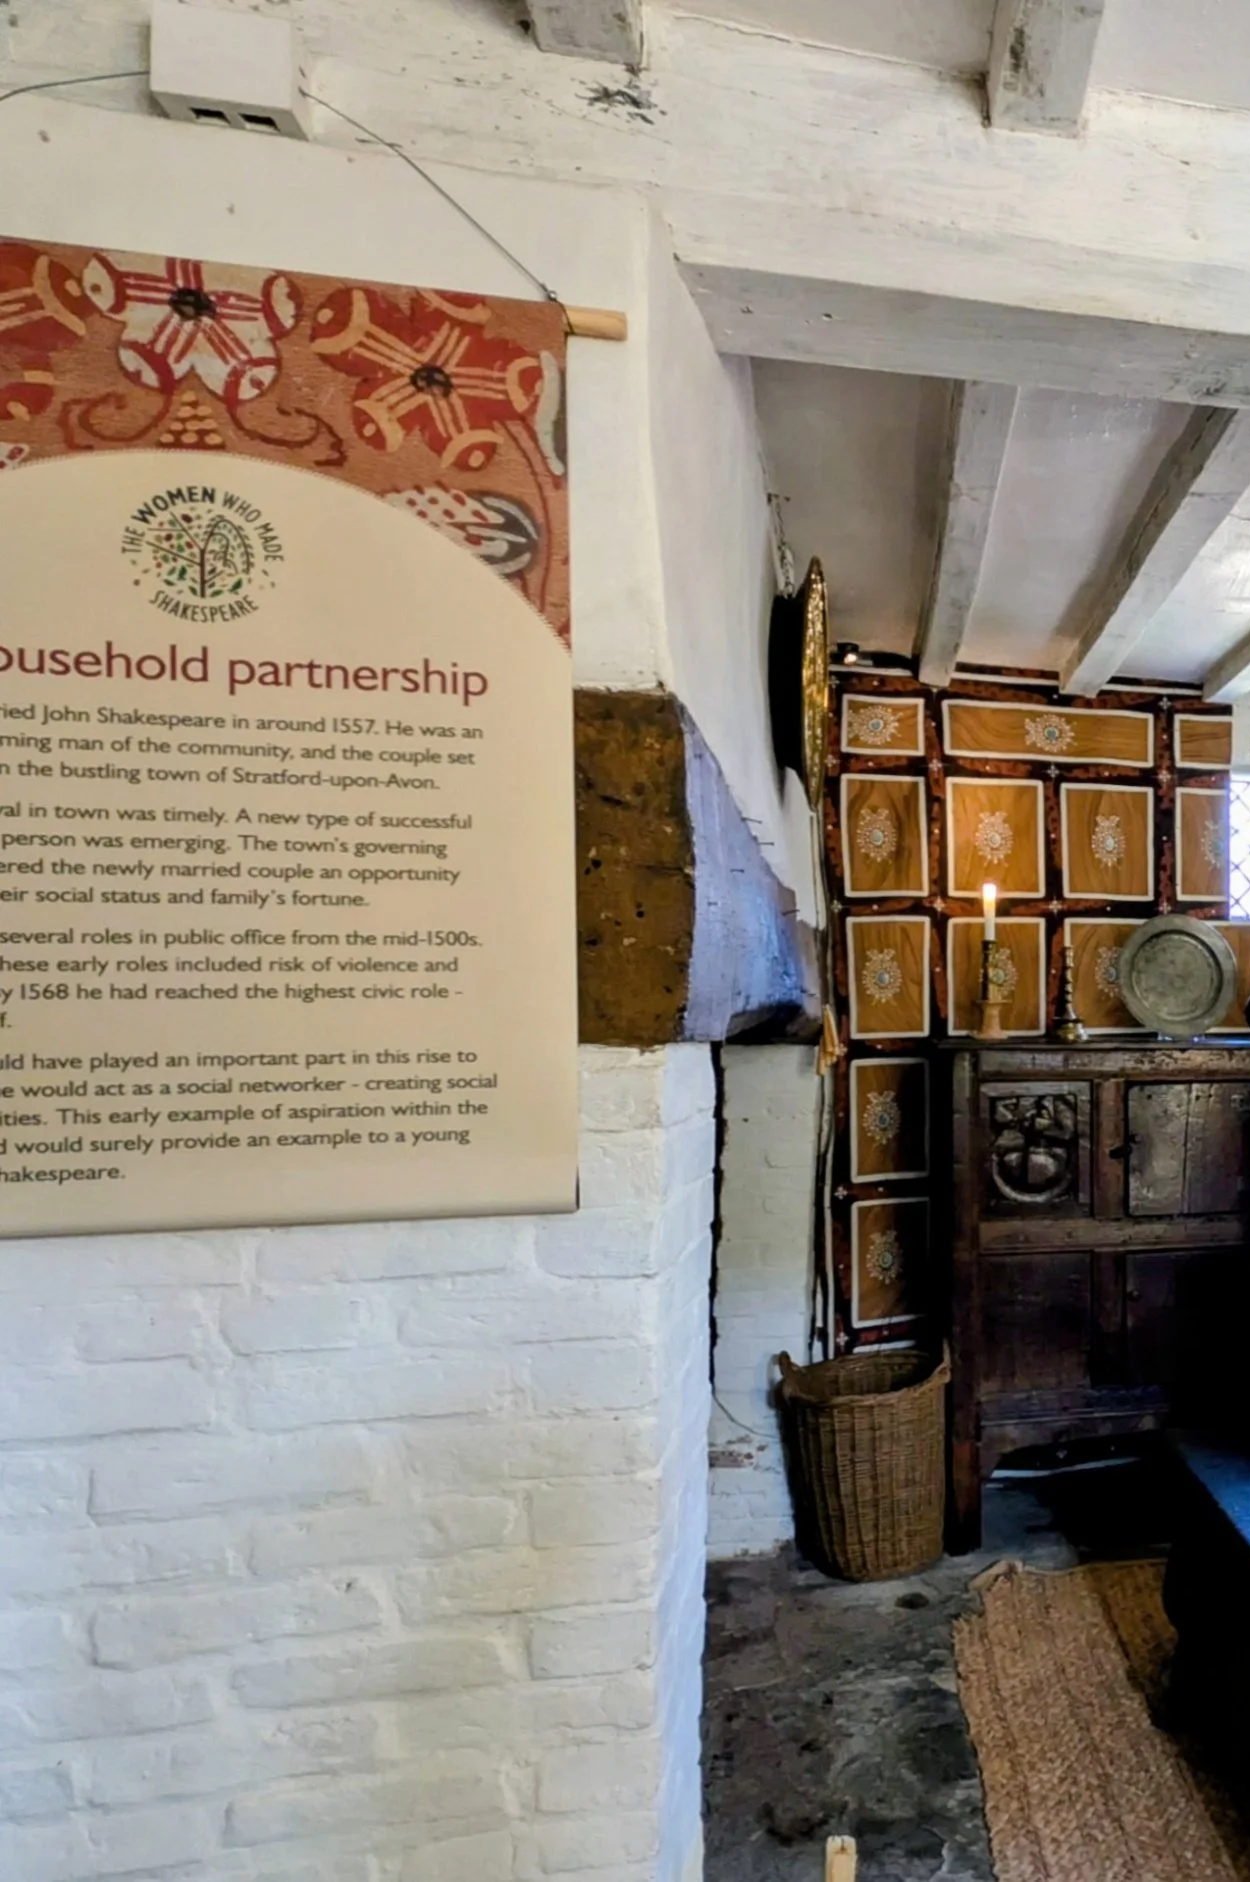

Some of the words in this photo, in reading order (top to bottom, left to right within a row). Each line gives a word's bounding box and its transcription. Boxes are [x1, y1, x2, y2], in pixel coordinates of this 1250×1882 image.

[130, 486, 216, 525] WOMEN
[222, 491, 262, 523] WHO
[121, 525, 146, 554] THE
[253, 521, 284, 563] MADE
[148, 589, 260, 623] SHAKESPEARE
[227, 657, 489, 708] partnership
[40, 704, 91, 726] John
[96, 705, 227, 732] Shakespeare
[231, 714, 250, 730] in
[255, 716, 327, 733] around
[332, 717, 380, 736] 1557.
[384, 719, 415, 737] He
[418, 725, 457, 739] was
[460, 727, 484, 740] an
[57, 737, 105, 752] man
[109, 735, 134, 753] of
[136, 736, 172, 754] the
[176, 742, 295, 763] community,
[299, 743, 337, 761] and
[340, 744, 375, 762] the
[377, 747, 443, 768] couple
[446, 752, 476, 766] set
[16, 759, 54, 778] the
[59, 760, 142, 785] bustling
[146, 767, 201, 783] town
[205, 765, 229, 784] of
[231, 766, 441, 792] Stratford-upon-Avon.
[28, 802, 48, 819] in
[53, 805, 111, 821] town
[115, 808, 157, 822] was
[162, 806, 229, 828] timely.
[234, 807, 253, 824] A
[257, 812, 302, 825] new
[305, 812, 351, 831] type
[353, 810, 376, 828] of
[379, 812, 473, 830] successful
[0, 833, 77, 851] person
[81, 835, 125, 849] was
[129, 834, 232, 856] emerging.
[236, 833, 279, 852] The
[283, 836, 350, 854] town's
[352, 839, 449, 861] governing
[50, 857, 87, 876] the
[92, 859, 156, 881] newly
[160, 861, 242, 879] married
[246, 862, 315, 884] couple
[318, 867, 343, 880] an
[347, 866, 461, 887] opportunity
[34, 885, 95, 904] social
[100, 889, 162, 905] status
[166, 887, 205, 905] and
[209, 887, 287, 911] family's
[291, 889, 370, 907] fortune.
[0, 927, 75, 945] several
[80, 927, 134, 945] roles
[138, 928, 158, 945] in
[163, 928, 226, 950] public
[229, 928, 287, 946] office
[290, 928, 341, 946] from
[344, 929, 378, 947] the
[382, 929, 483, 947] mid-1500s.
[55, 955, 110, 978] early
[115, 955, 169, 973] roles
[175, 955, 263, 973] included
[268, 955, 306, 973] risk
[310, 955, 334, 973] of
[336, 956, 420, 973] violence
[423, 956, 459, 973] and
[19, 982, 71, 1001] 1568
[75, 982, 104, 1001] he
[109, 982, 149, 1001] had
[154, 982, 239, 1000] reached
[244, 982, 280, 1000] the
[283, 982, 357, 1004] highest
[361, 983, 406, 1000] civic
[409, 982, 450, 999] role
[31, 1052, 84, 1071] have
[89, 1050, 159, 1074] played
[164, 1055, 191, 1068] an
[196, 1051, 301, 1072] important
[304, 1052, 347, 1071] part
[351, 1049, 371, 1065] in
[375, 1048, 412, 1065] this
[416, 1048, 452, 1064] rise
[456, 1050, 479, 1064] to
[19, 1079, 89, 1099] would
[93, 1082, 127, 1097] act
[131, 1083, 155, 1097] as
[158, 1082, 173, 1096] a
[176, 1076, 234, 1096] social
[238, 1075, 347, 1094] networker
[363, 1075, 443, 1095] creating
[446, 1072, 498, 1090] social
[54, 1107, 103, 1126] This
[107, 1106, 162, 1129] early
[166, 1103, 256, 1126] example
[260, 1103, 284, 1121] of
[287, 1102, 386, 1124] aspiration
[390, 1100, 452, 1117] within
[456, 1098, 489, 1116] the
[13, 1135, 84, 1155] would
[89, 1133, 155, 1156] surely
[160, 1131, 241, 1155] provide
[246, 1134, 271, 1148] an
[275, 1128, 363, 1150] example
[367, 1130, 390, 1144] to
[394, 1131, 407, 1144] a
[410, 1129, 472, 1148] young
